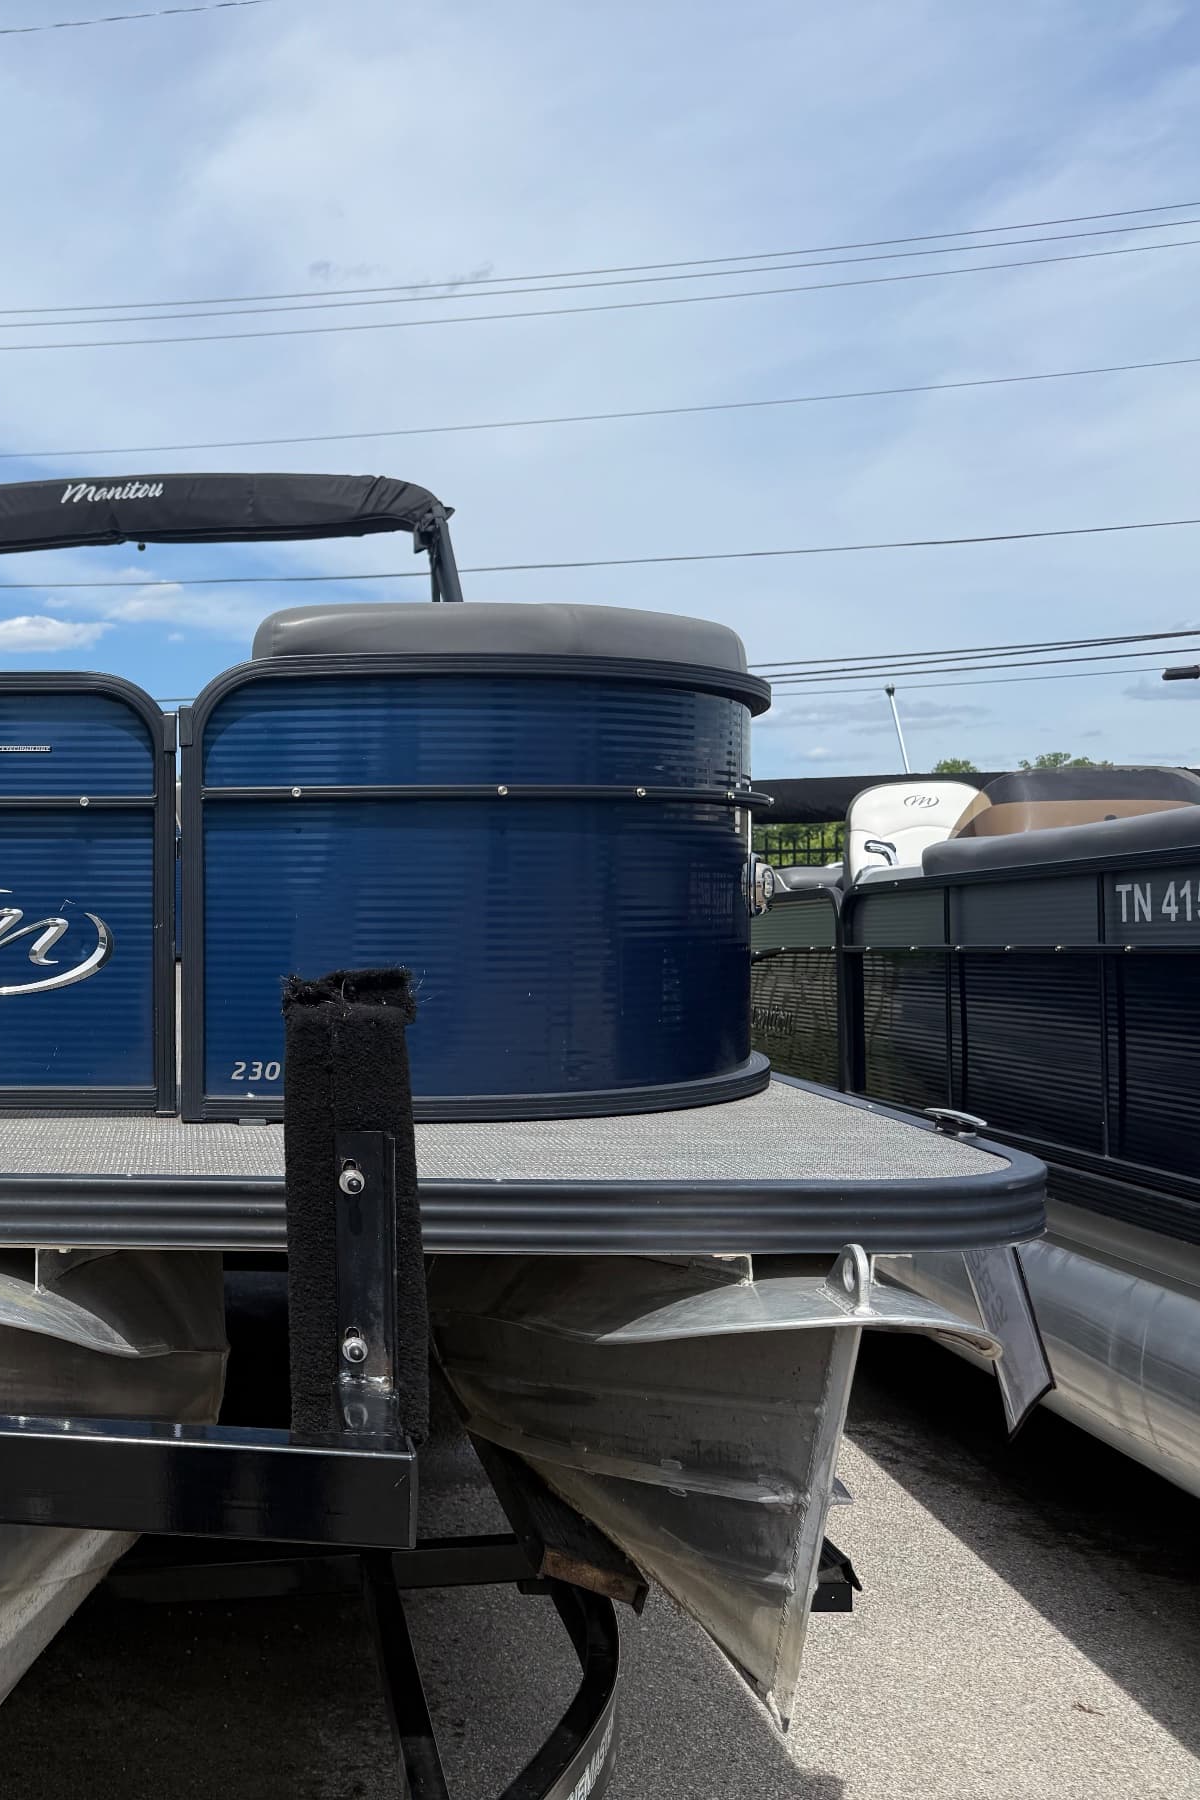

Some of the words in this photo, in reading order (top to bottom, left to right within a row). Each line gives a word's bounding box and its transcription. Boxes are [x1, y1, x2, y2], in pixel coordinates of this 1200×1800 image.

[61, 481, 164, 504] Manitou
[1115, 883, 1152, 923] TN
[1161, 880, 1200, 922] 41
[231, 1061, 281, 1081] 230
